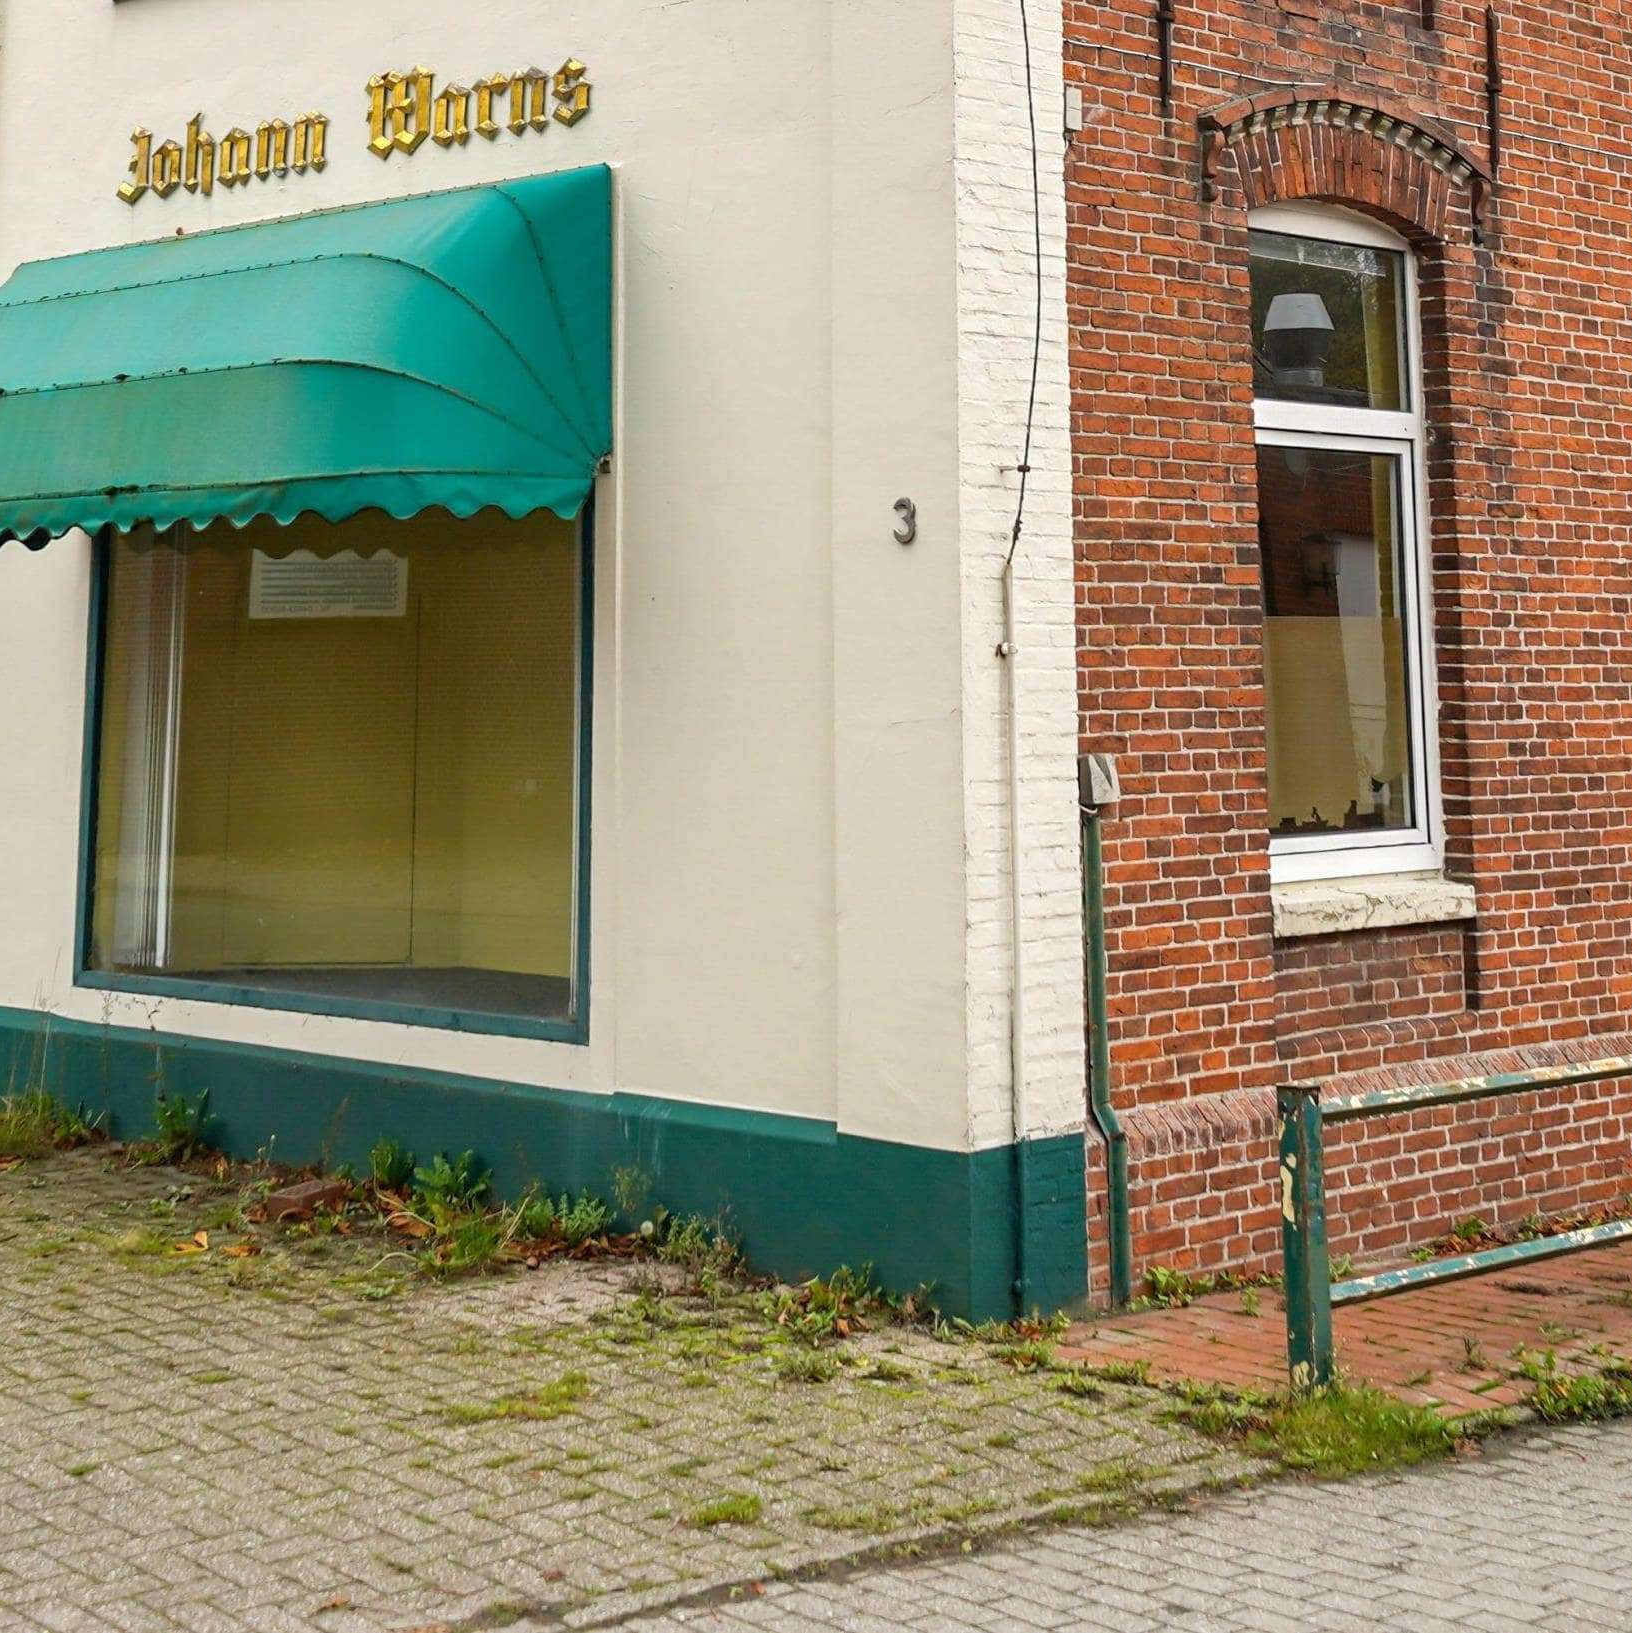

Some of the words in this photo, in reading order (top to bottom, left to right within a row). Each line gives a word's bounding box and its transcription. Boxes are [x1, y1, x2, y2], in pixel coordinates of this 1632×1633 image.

[116, 111, 330, 205] Johann
[365, 56, 591, 160] Warns
[893, 497, 916, 545] 3
